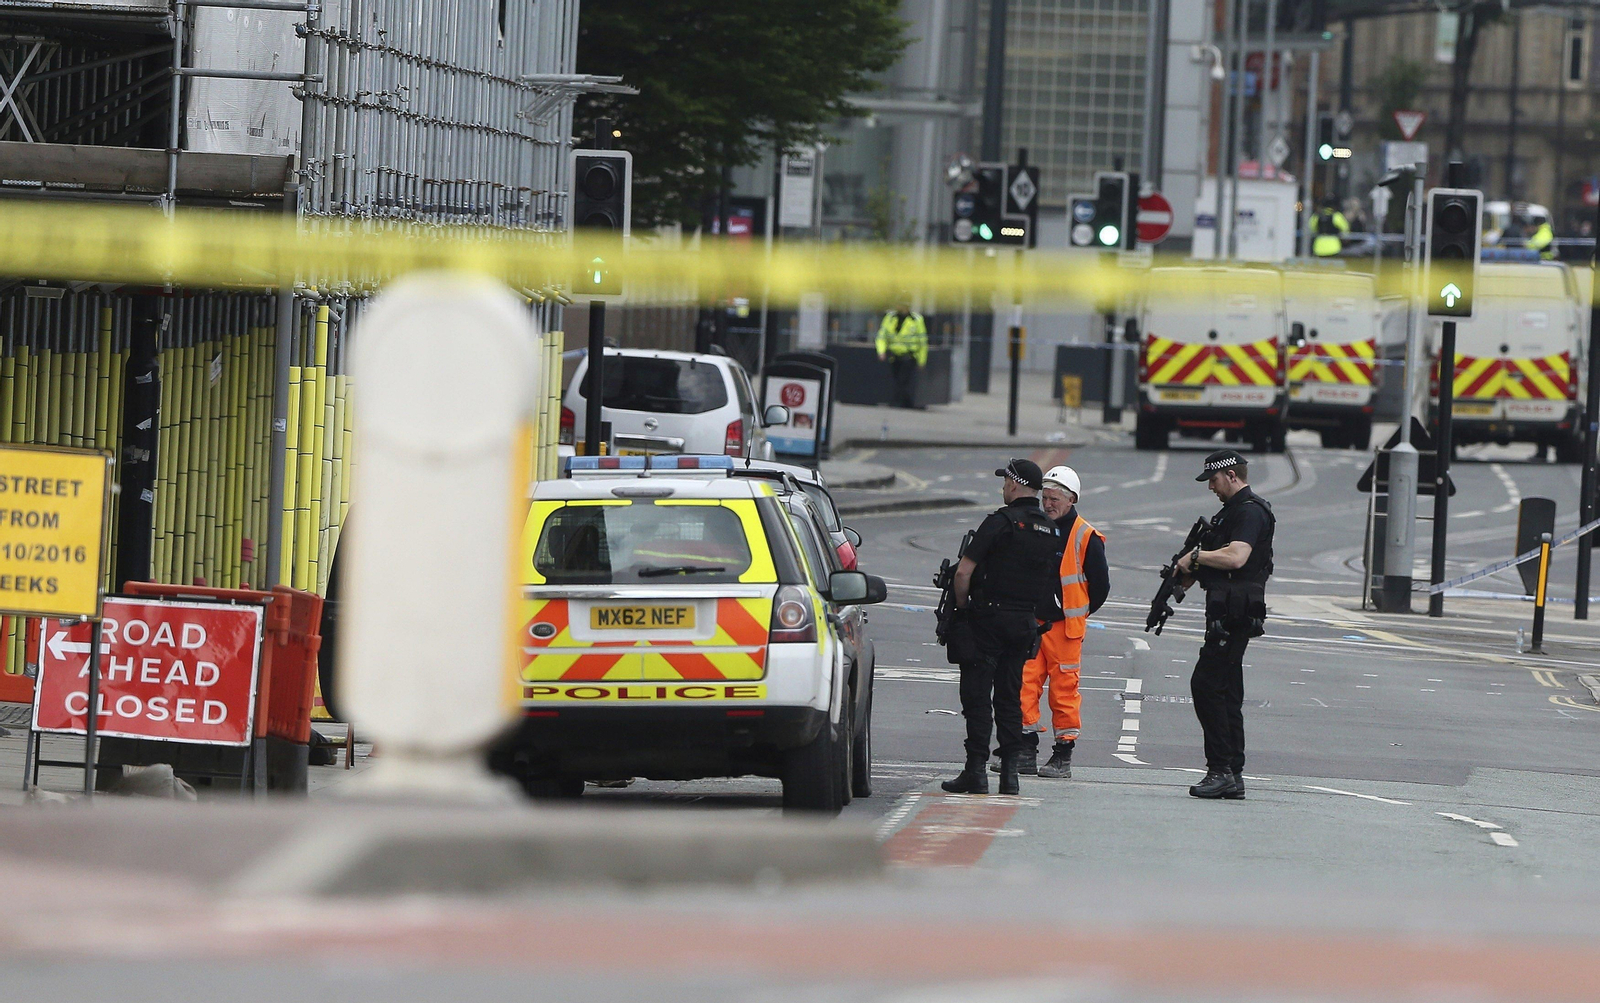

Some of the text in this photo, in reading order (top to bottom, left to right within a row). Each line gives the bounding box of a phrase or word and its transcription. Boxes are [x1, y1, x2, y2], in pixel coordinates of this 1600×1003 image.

[0, 475, 83, 497] STREET
[0, 508, 59, 529] FROM
[598, 608, 687, 626] MX62 NEF
[100, 617, 207, 650] ROAD
[523, 686, 760, 699] POLICE
[64, 691, 228, 725] CLOSED
